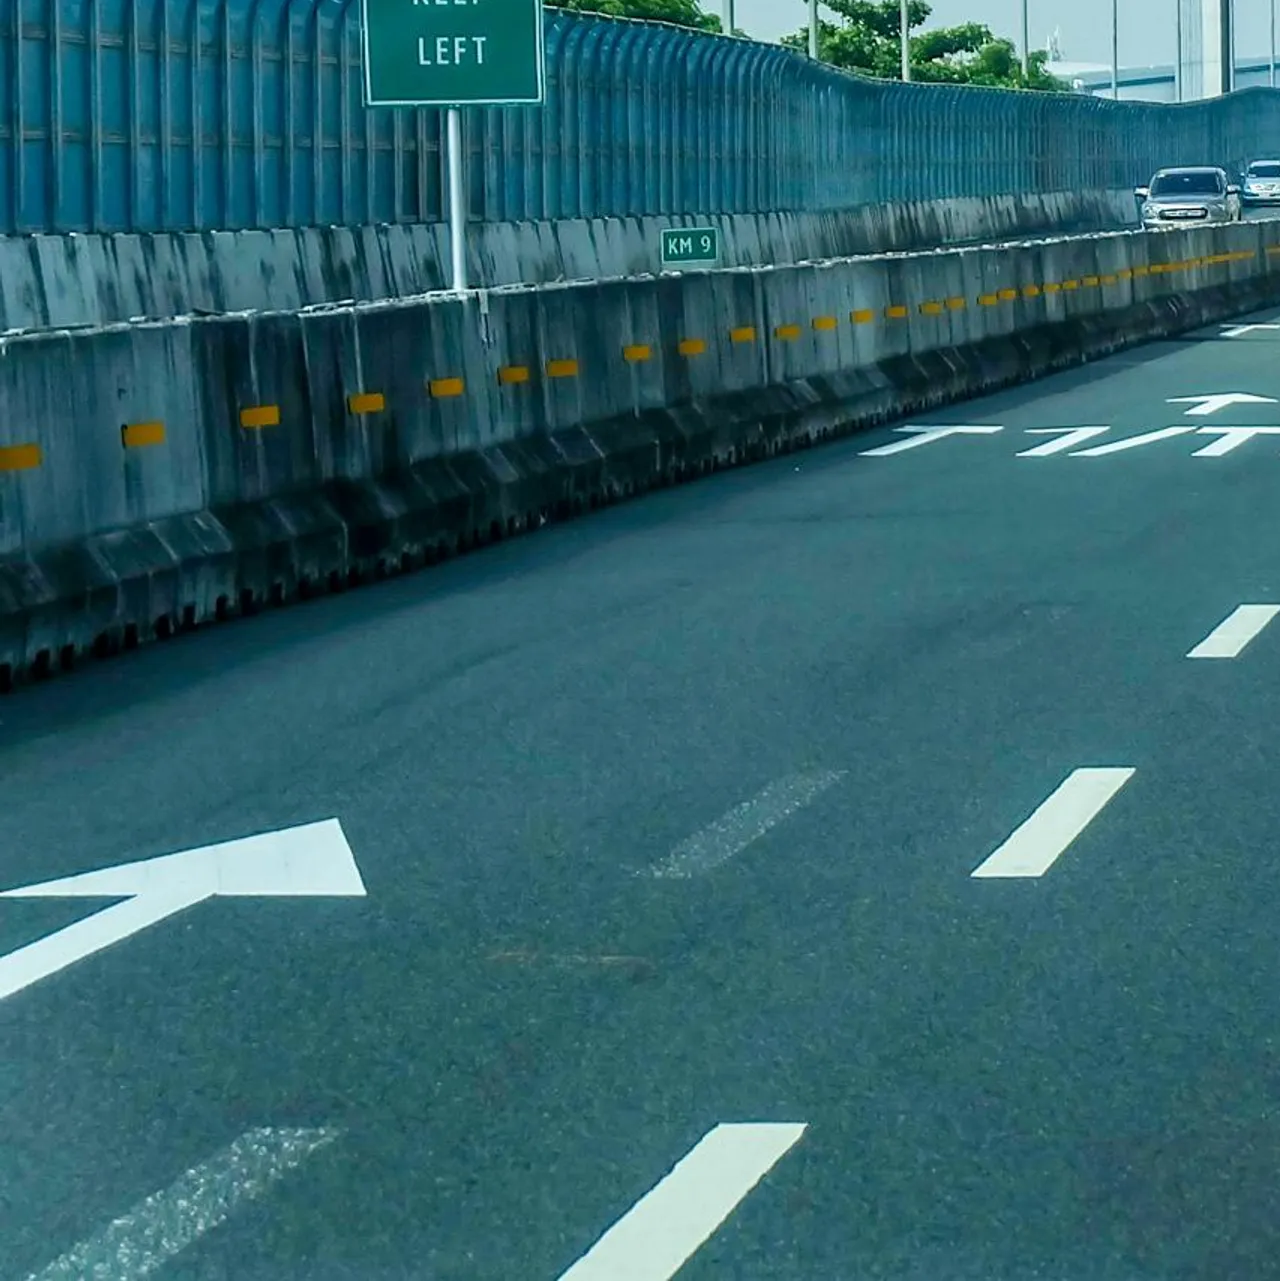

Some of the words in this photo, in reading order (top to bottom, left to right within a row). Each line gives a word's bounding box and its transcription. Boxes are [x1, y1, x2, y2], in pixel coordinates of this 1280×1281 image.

[418, 36, 487, 66] LEFT
[668, 236, 693, 255] KM
[700, 234, 712, 253] 9
